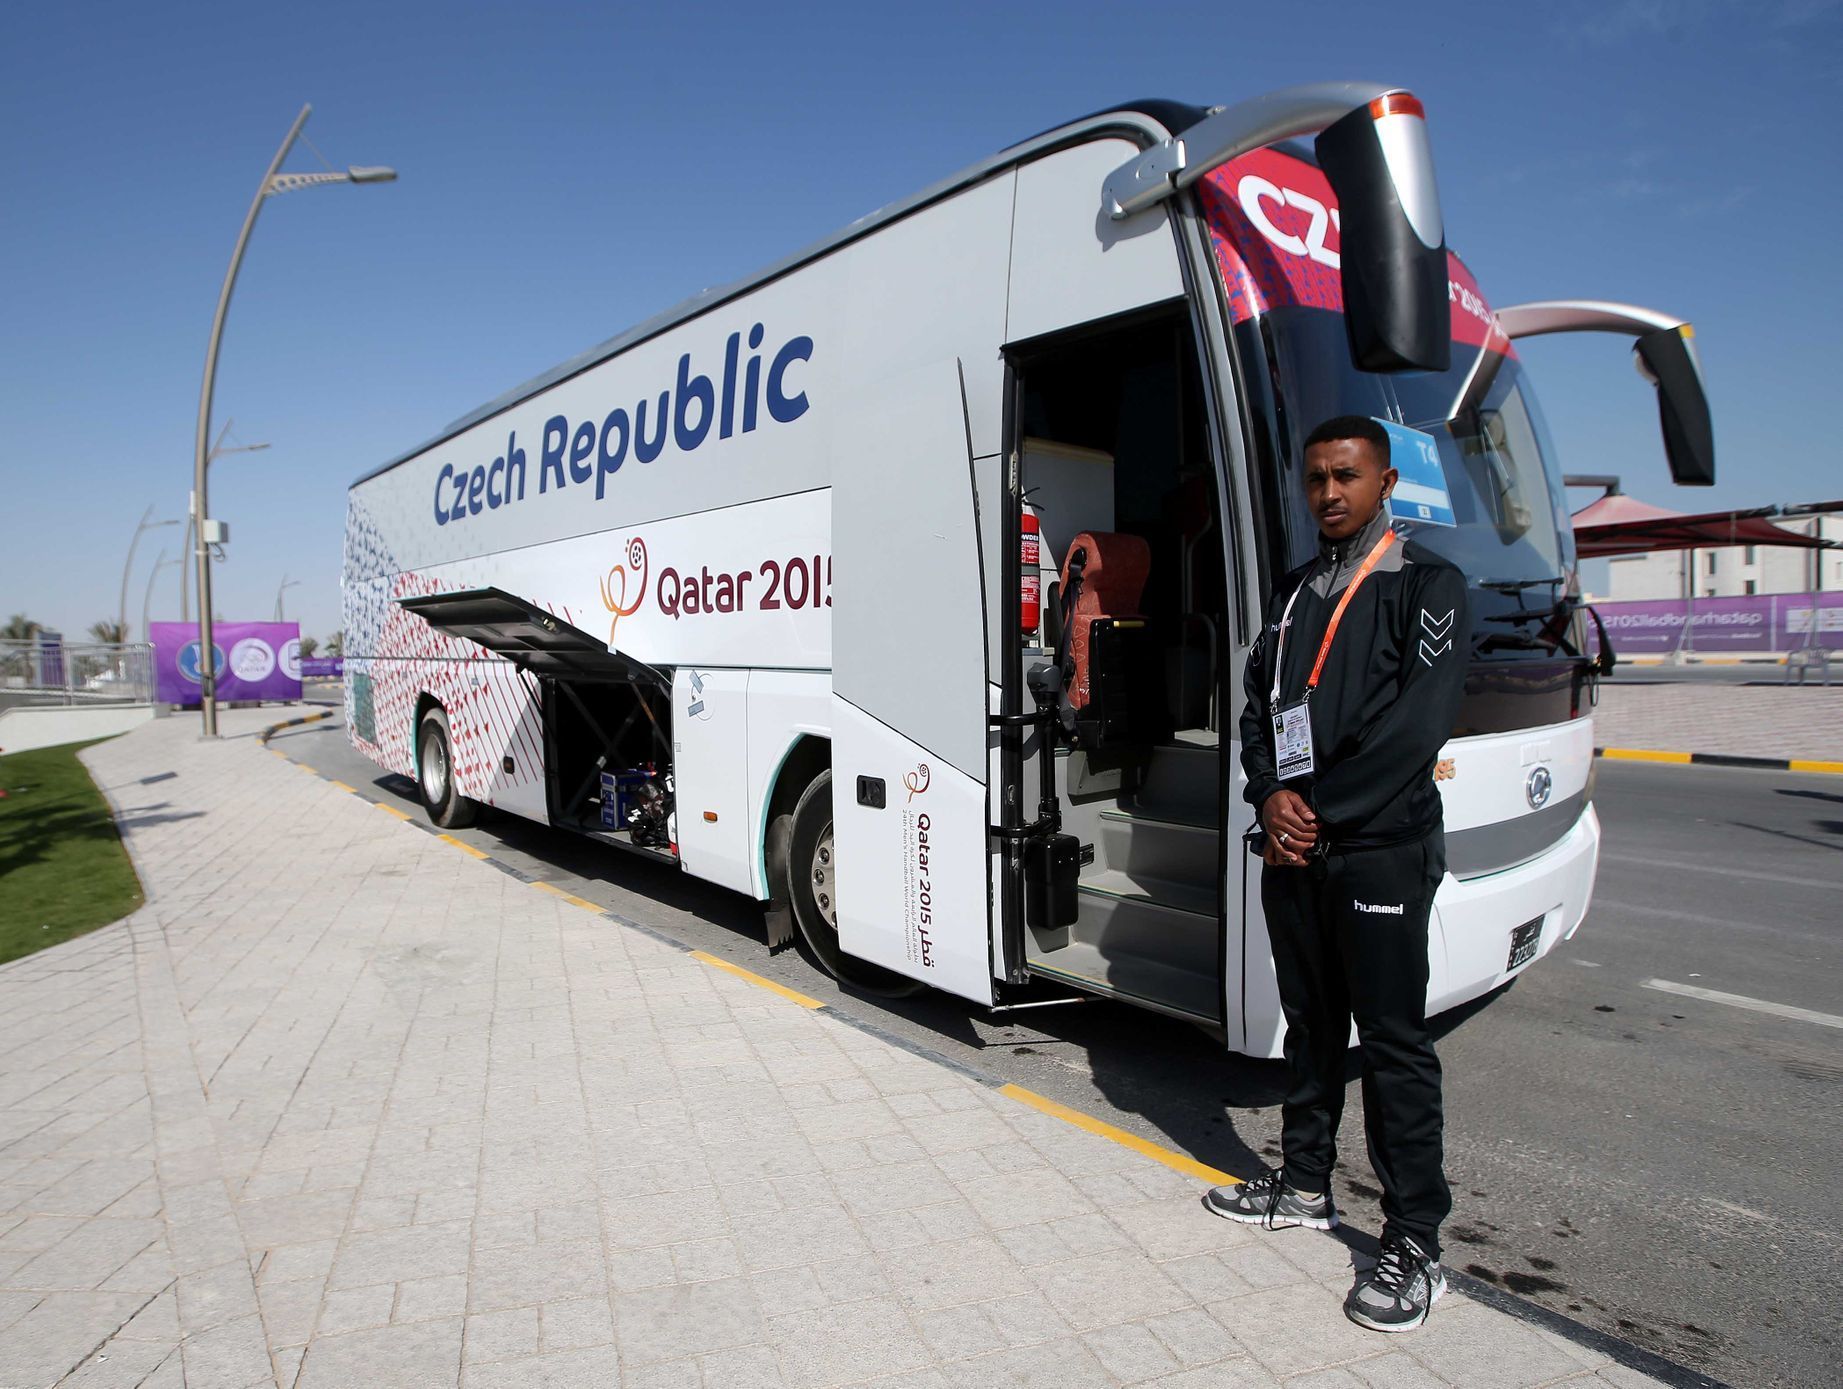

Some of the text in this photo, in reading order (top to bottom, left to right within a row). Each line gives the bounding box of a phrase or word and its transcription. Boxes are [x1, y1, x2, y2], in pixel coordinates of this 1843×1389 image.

[1238, 175, 1340, 270] CZ
[434, 322, 814, 526] Czech Republic
[657, 566, 752, 620] Qatar
[1270, 616, 1293, 632] huel
[917, 813, 932, 926] Qatar 2015
[1354, 899, 1404, 915] hummel
[904, 909, 912, 961] Championship
[917, 925, 935, 968] قطر
